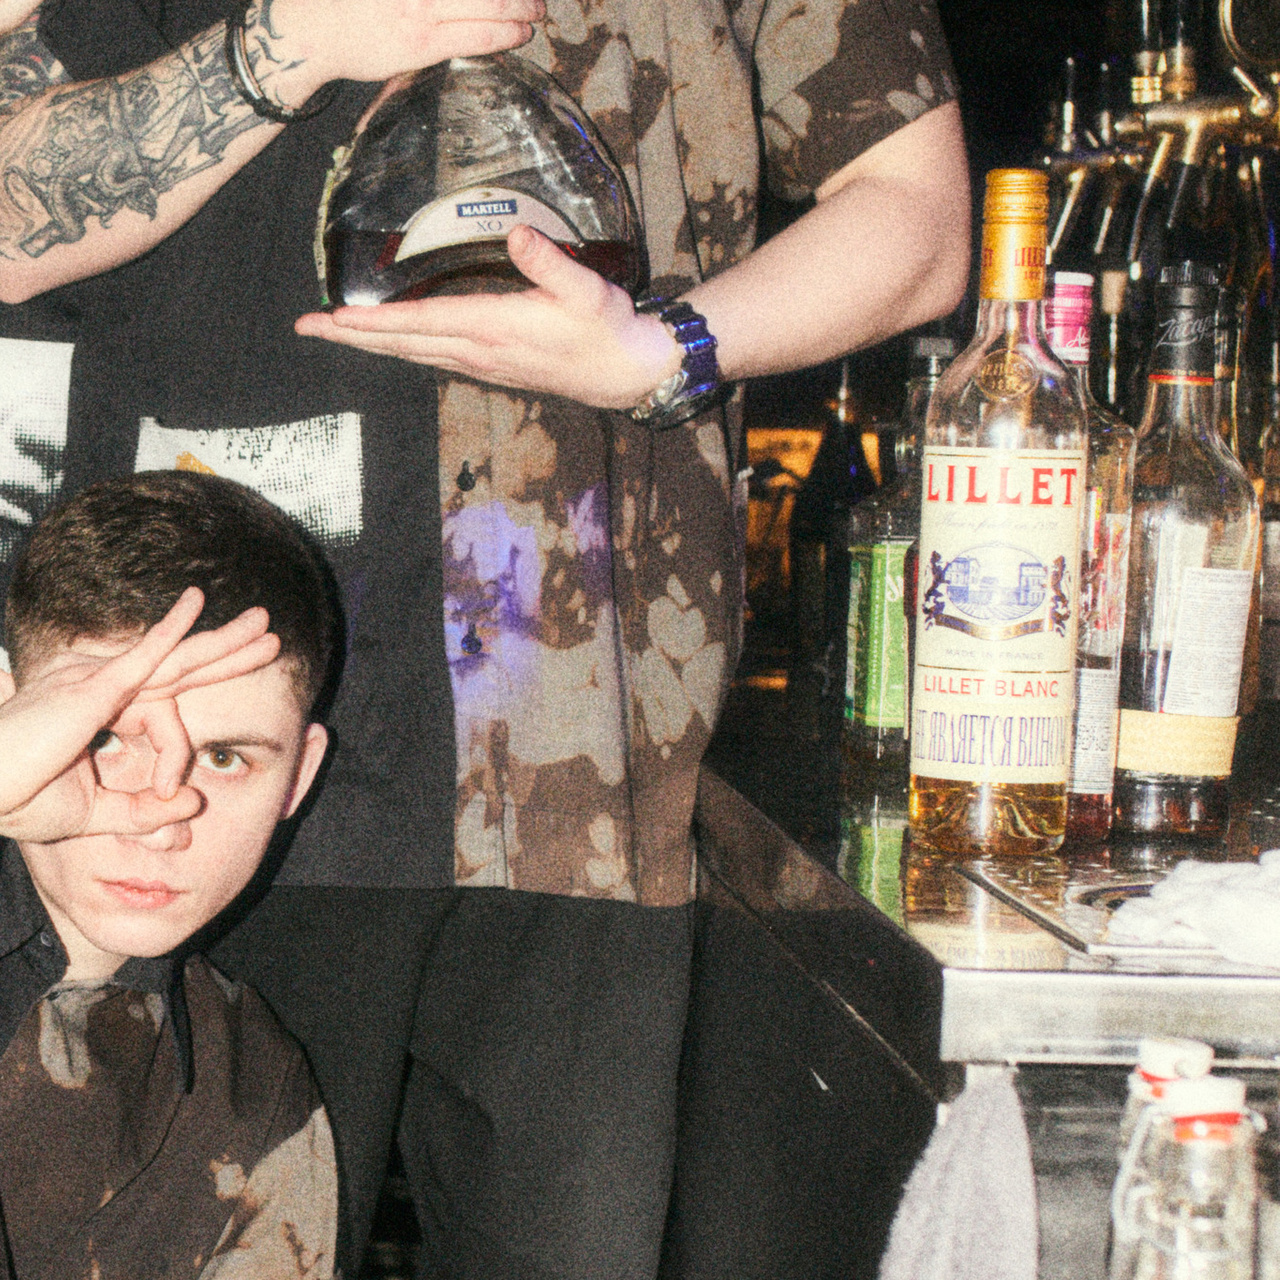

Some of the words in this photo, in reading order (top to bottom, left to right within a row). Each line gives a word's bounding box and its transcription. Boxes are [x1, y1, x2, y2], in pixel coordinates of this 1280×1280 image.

[461, 203, 512, 216] MARTELL
[477, 221, 502, 232] XO
[926, 464, 1078, 505] LILLET
[946, 648, 975, 658] MADE
[999, 651, 1044, 660] FRANCE
[924, 675, 985, 695] LILLET
[995, 680, 1058, 698] BLANC
[928, 712, 1014, 766] ЯВЛЯЕТСЯ
